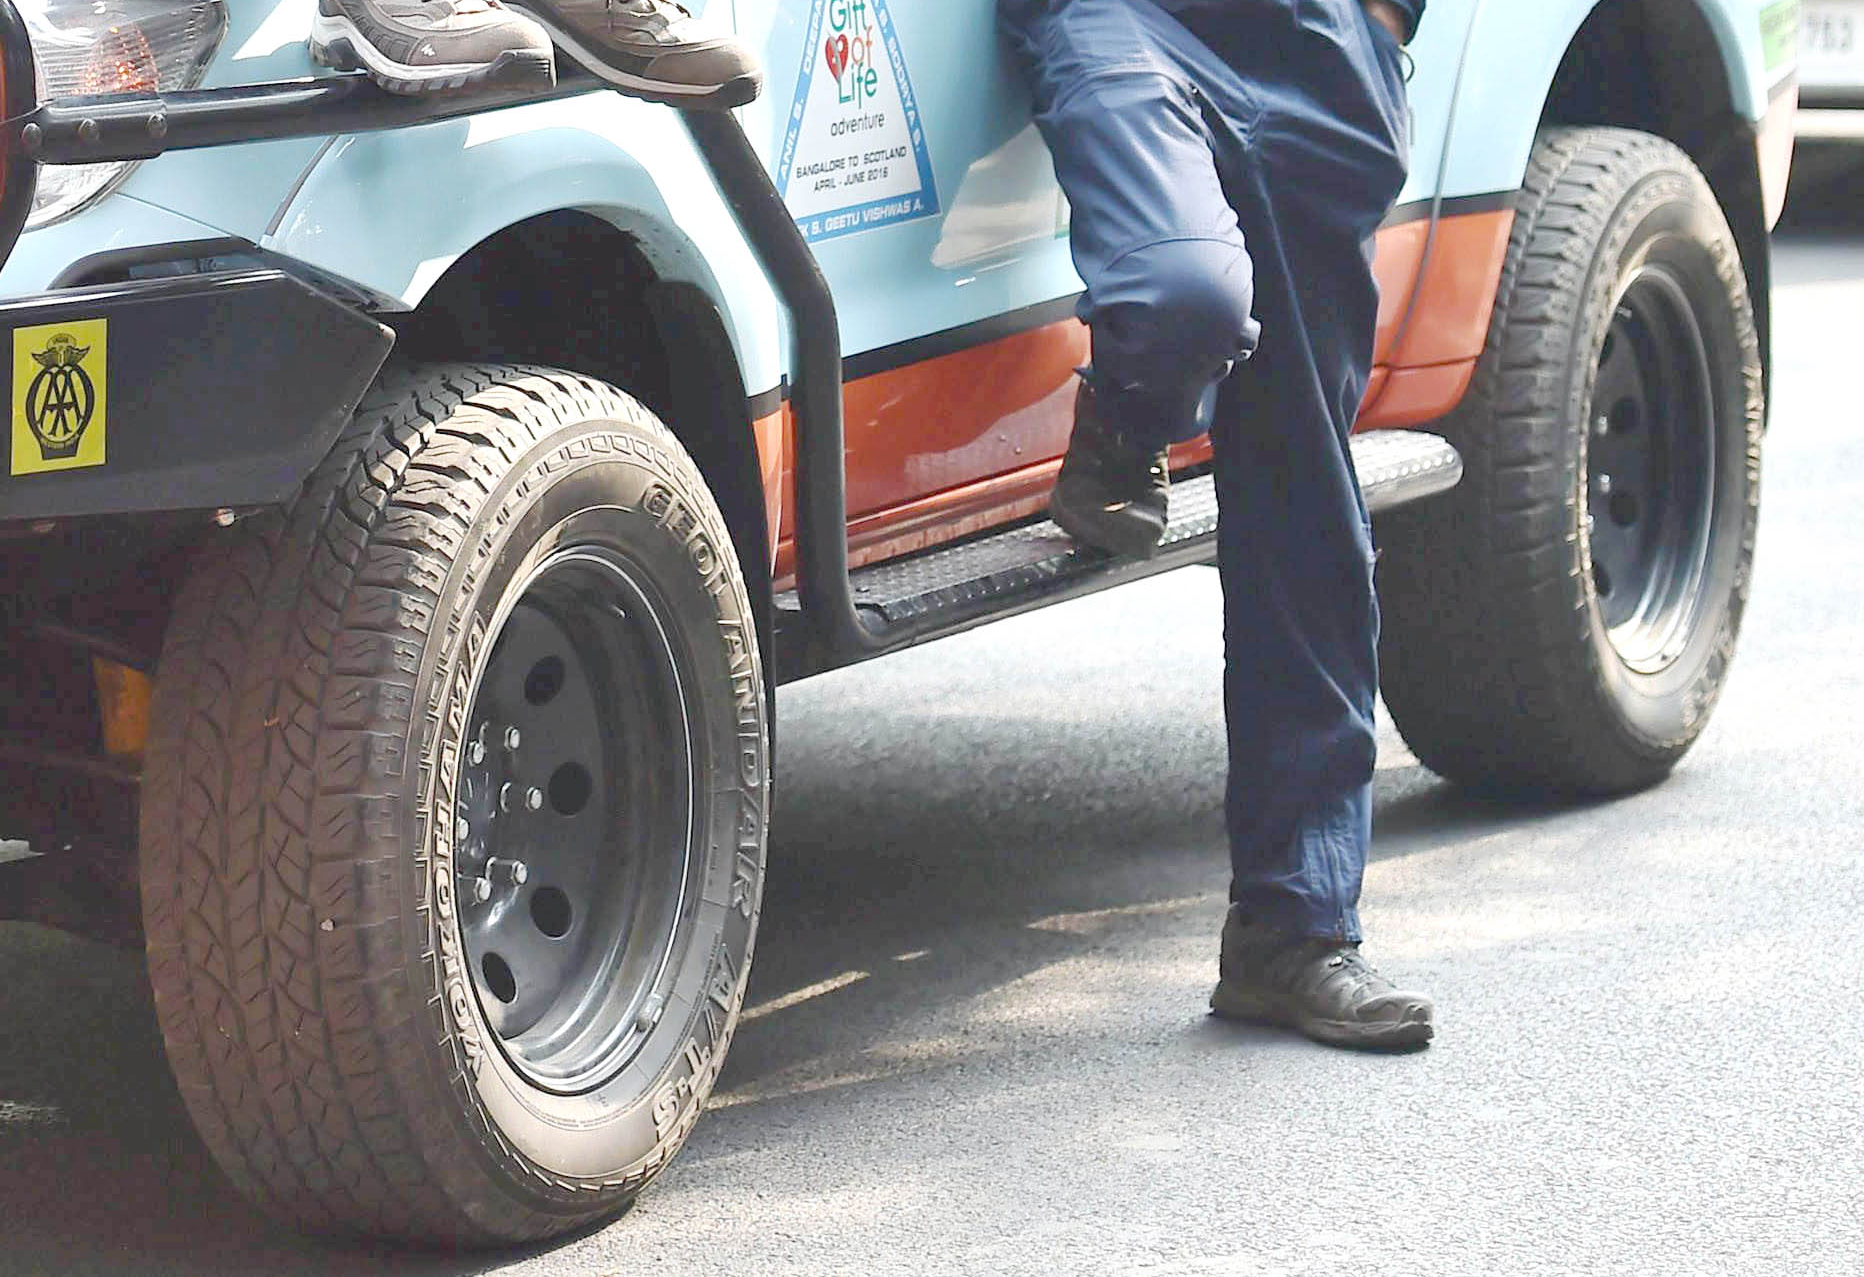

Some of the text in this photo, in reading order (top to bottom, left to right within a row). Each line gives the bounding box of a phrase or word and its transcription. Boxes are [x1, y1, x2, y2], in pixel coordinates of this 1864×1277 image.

[851, 24, 873, 68] of
[837, 61, 878, 110] Life
[830, 113, 886, 137] adventure
[796, 145, 908, 179] BANGALORE TO SCOTLAND
[814, 178, 837, 193] APRIL
[844, 171, 866, 187] JUNE
[863, 198, 912, 223] VISHWAS
